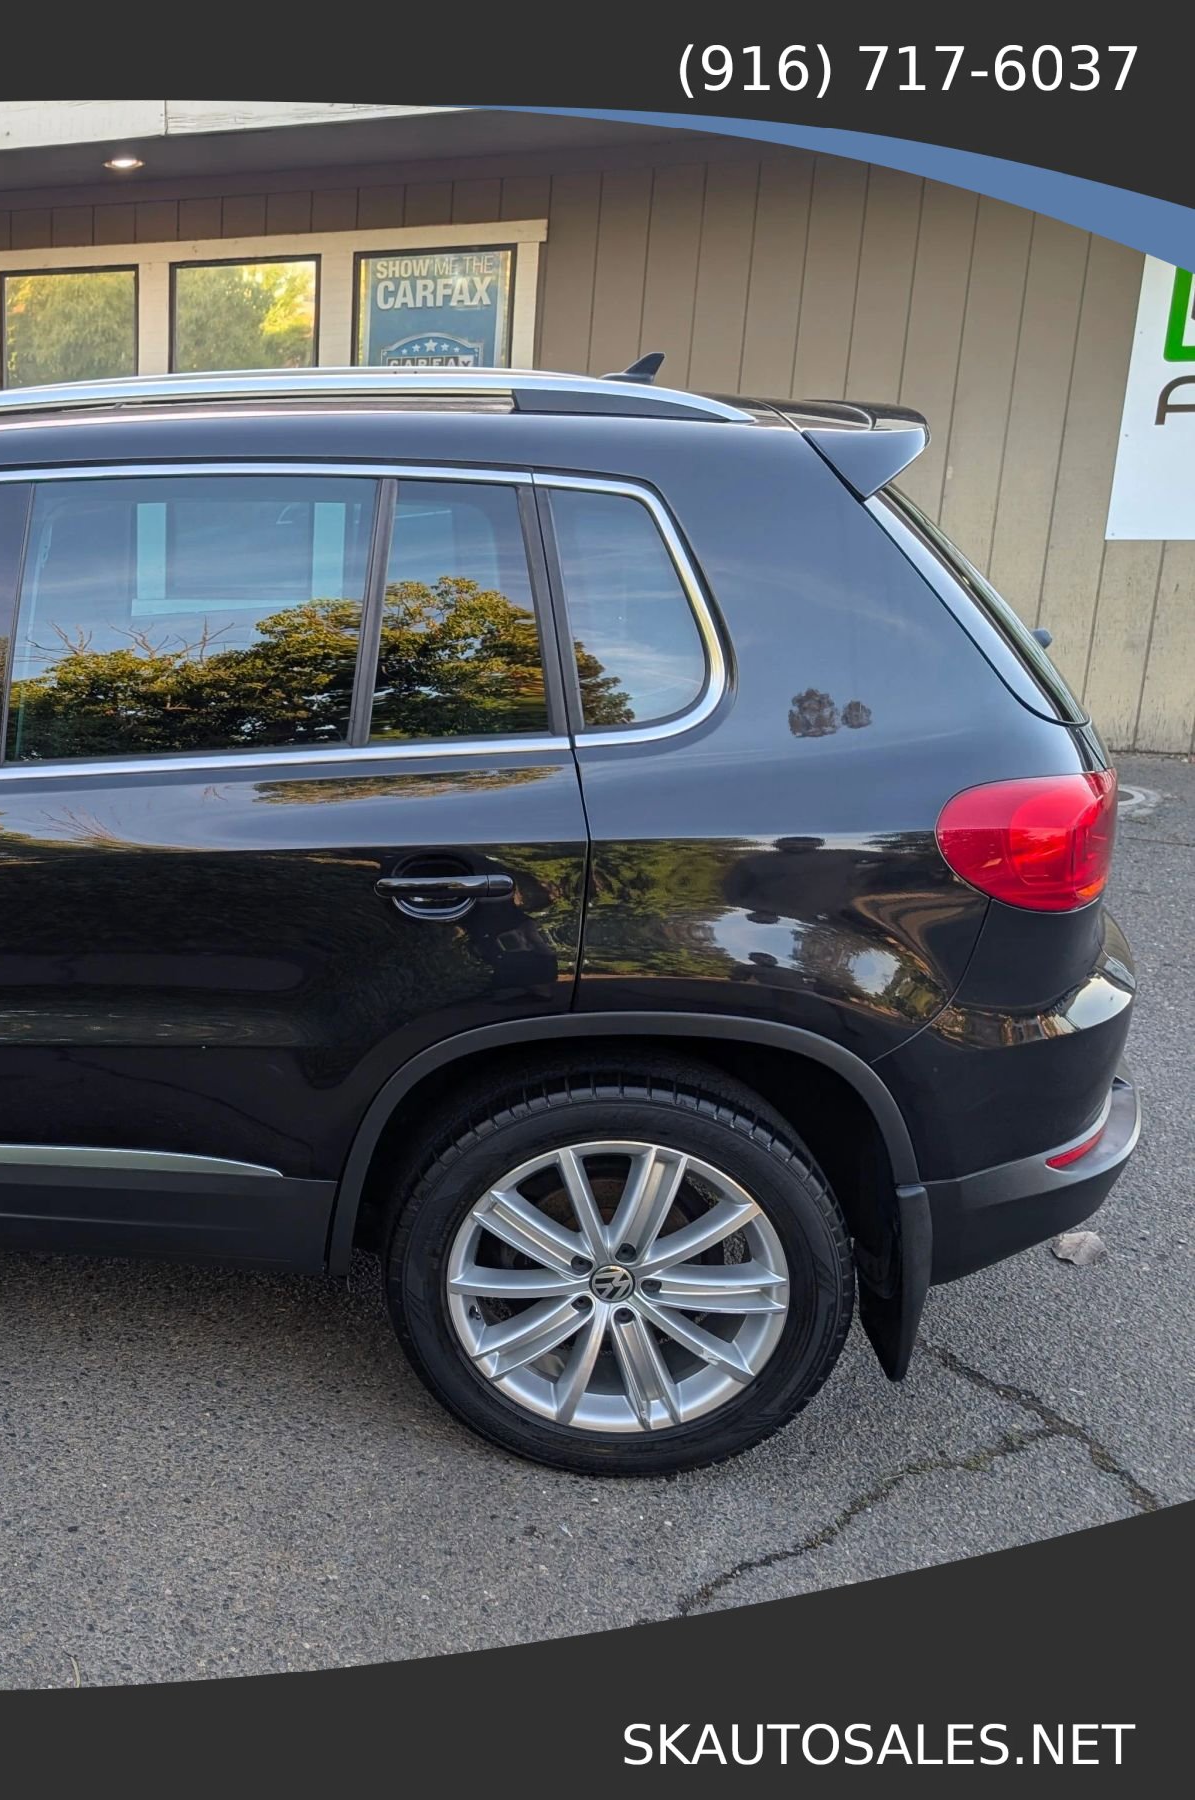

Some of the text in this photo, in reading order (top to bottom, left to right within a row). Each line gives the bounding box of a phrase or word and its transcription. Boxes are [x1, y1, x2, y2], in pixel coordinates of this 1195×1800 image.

[376, 255, 494, 279] SHOW ME THE
[376, 276, 493, 309] CARFAX
